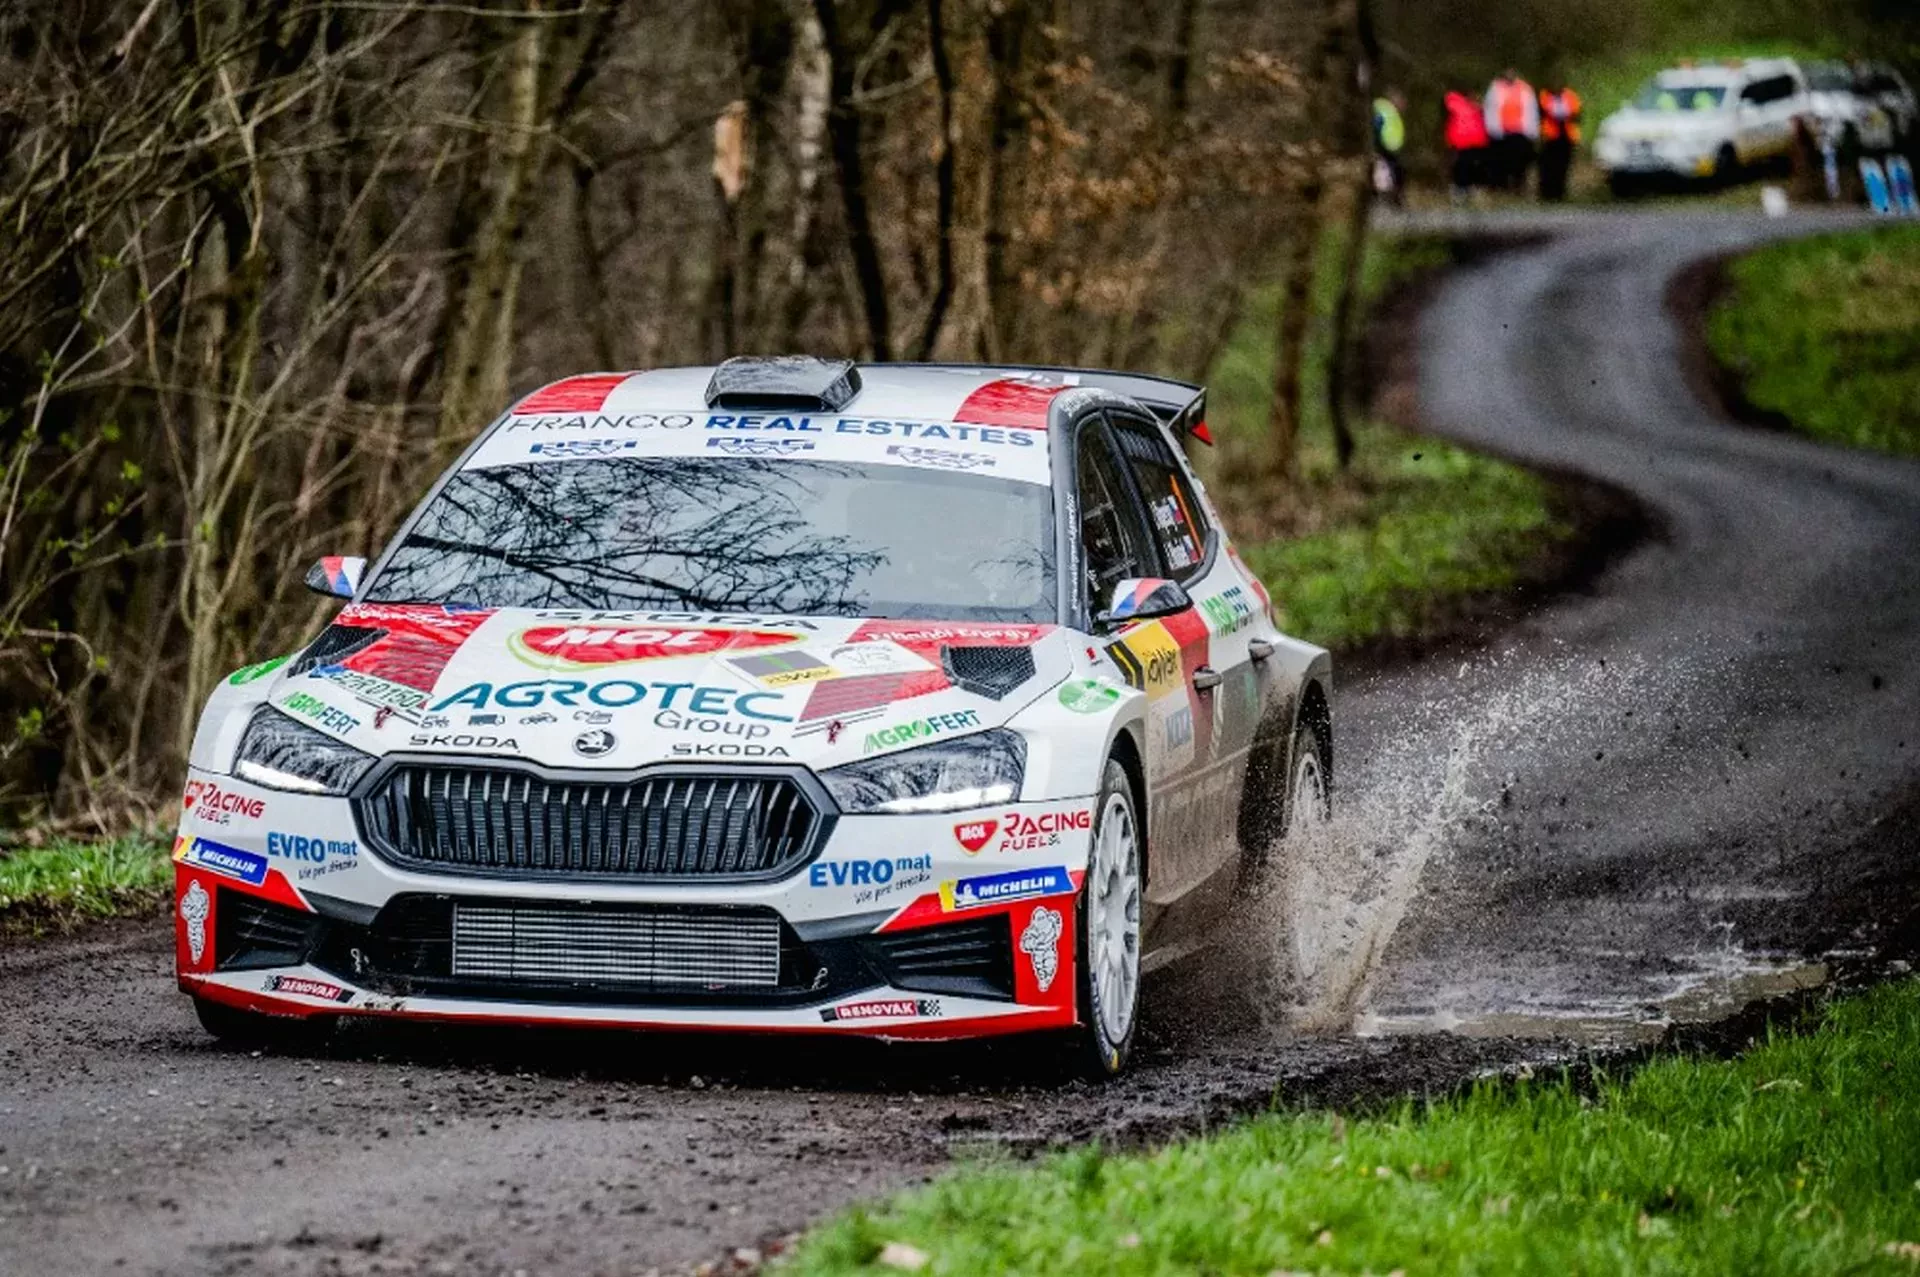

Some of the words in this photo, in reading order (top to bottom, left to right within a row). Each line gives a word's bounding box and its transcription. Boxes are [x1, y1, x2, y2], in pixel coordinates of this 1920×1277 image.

[507, 414, 694, 432] FRANCO
[704, 415, 823, 432] REAL
[836, 419, 1035, 447] ESTATES
[542, 627, 709, 647] MOL
[955, 627, 1031, 640] Energy
[281, 691, 361, 736] AGROFERT
[427, 679, 794, 723] AGROTEC
[653, 709, 772, 741] Group
[863, 709, 981, 754] AGROFERT
[202, 783, 266, 819] RACING
[1003, 810, 1090, 838] RACING
[200, 849, 258, 874] MICHELIN
[979, 876, 1057, 897] MICHELIN
[840, 1002, 914, 1017] RENOVAK
